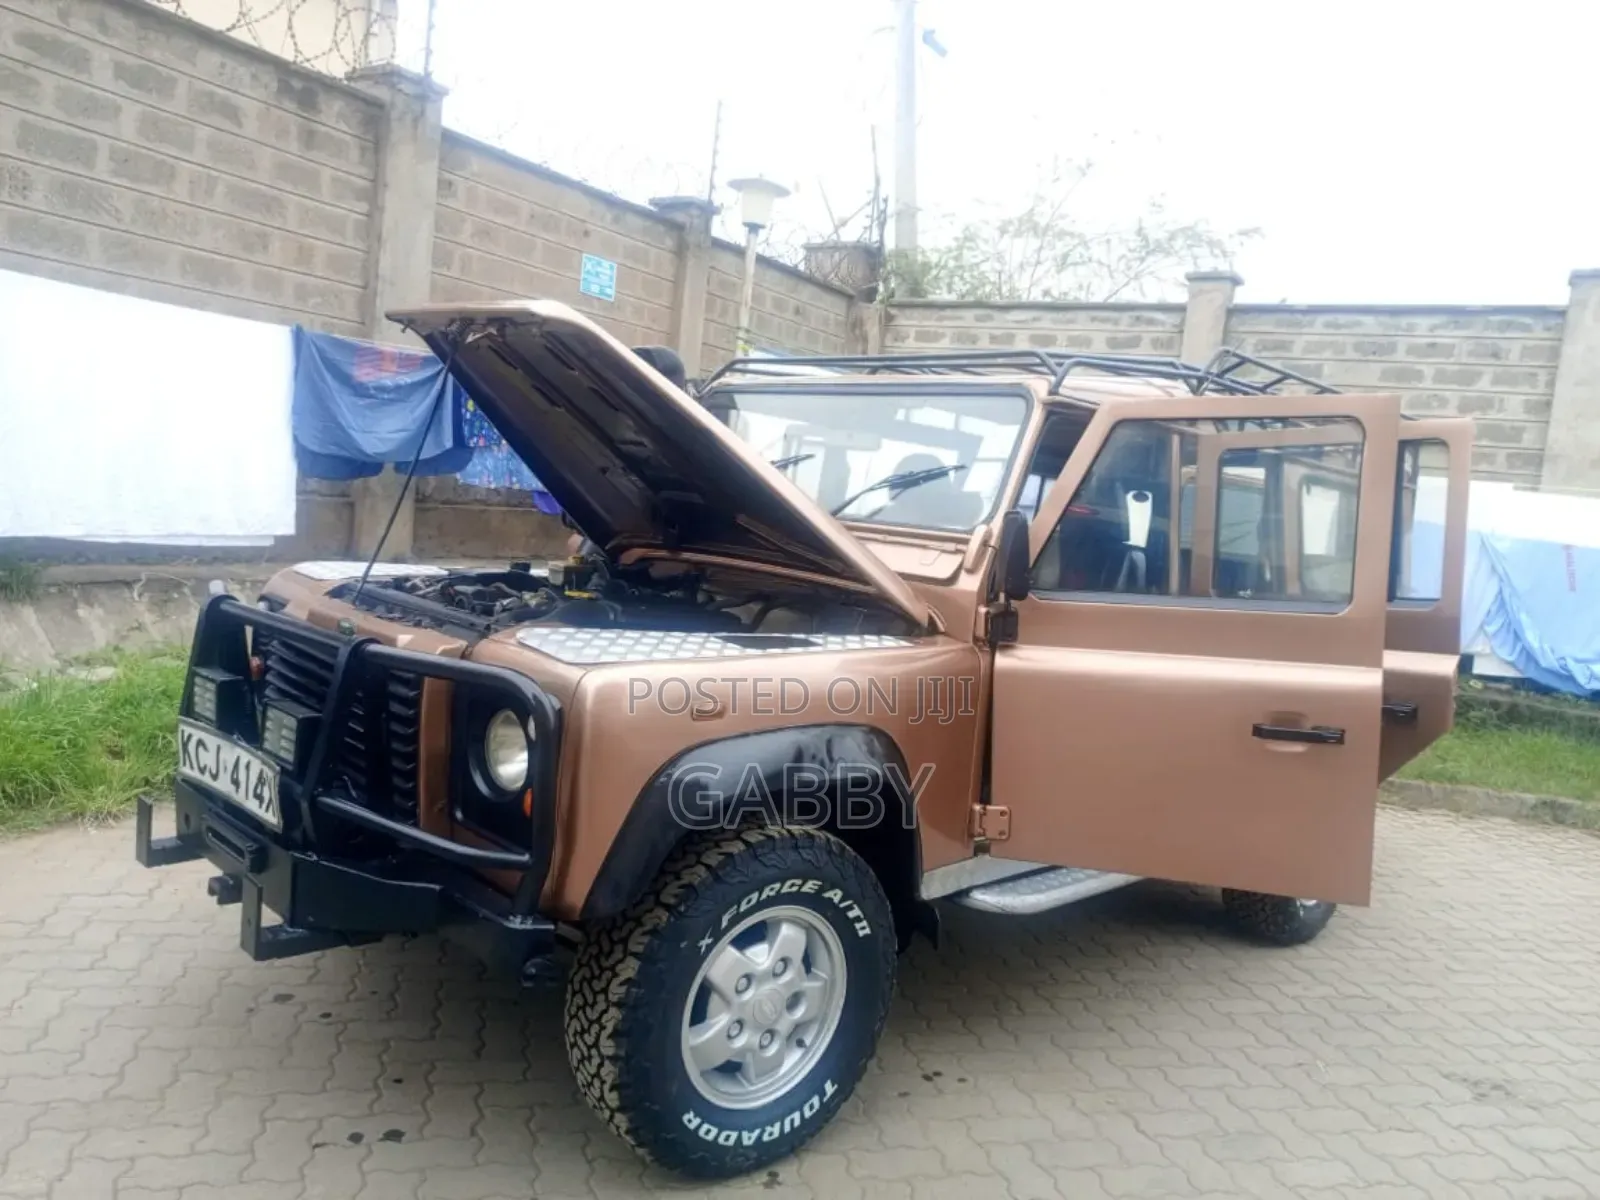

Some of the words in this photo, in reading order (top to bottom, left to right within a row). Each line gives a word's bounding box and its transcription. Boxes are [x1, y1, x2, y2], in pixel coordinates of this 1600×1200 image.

[181, 729, 221, 782] KCJ
[720, 878, 823, 930] FORCE
[681, 1079, 838, 1146] TOURADOR
